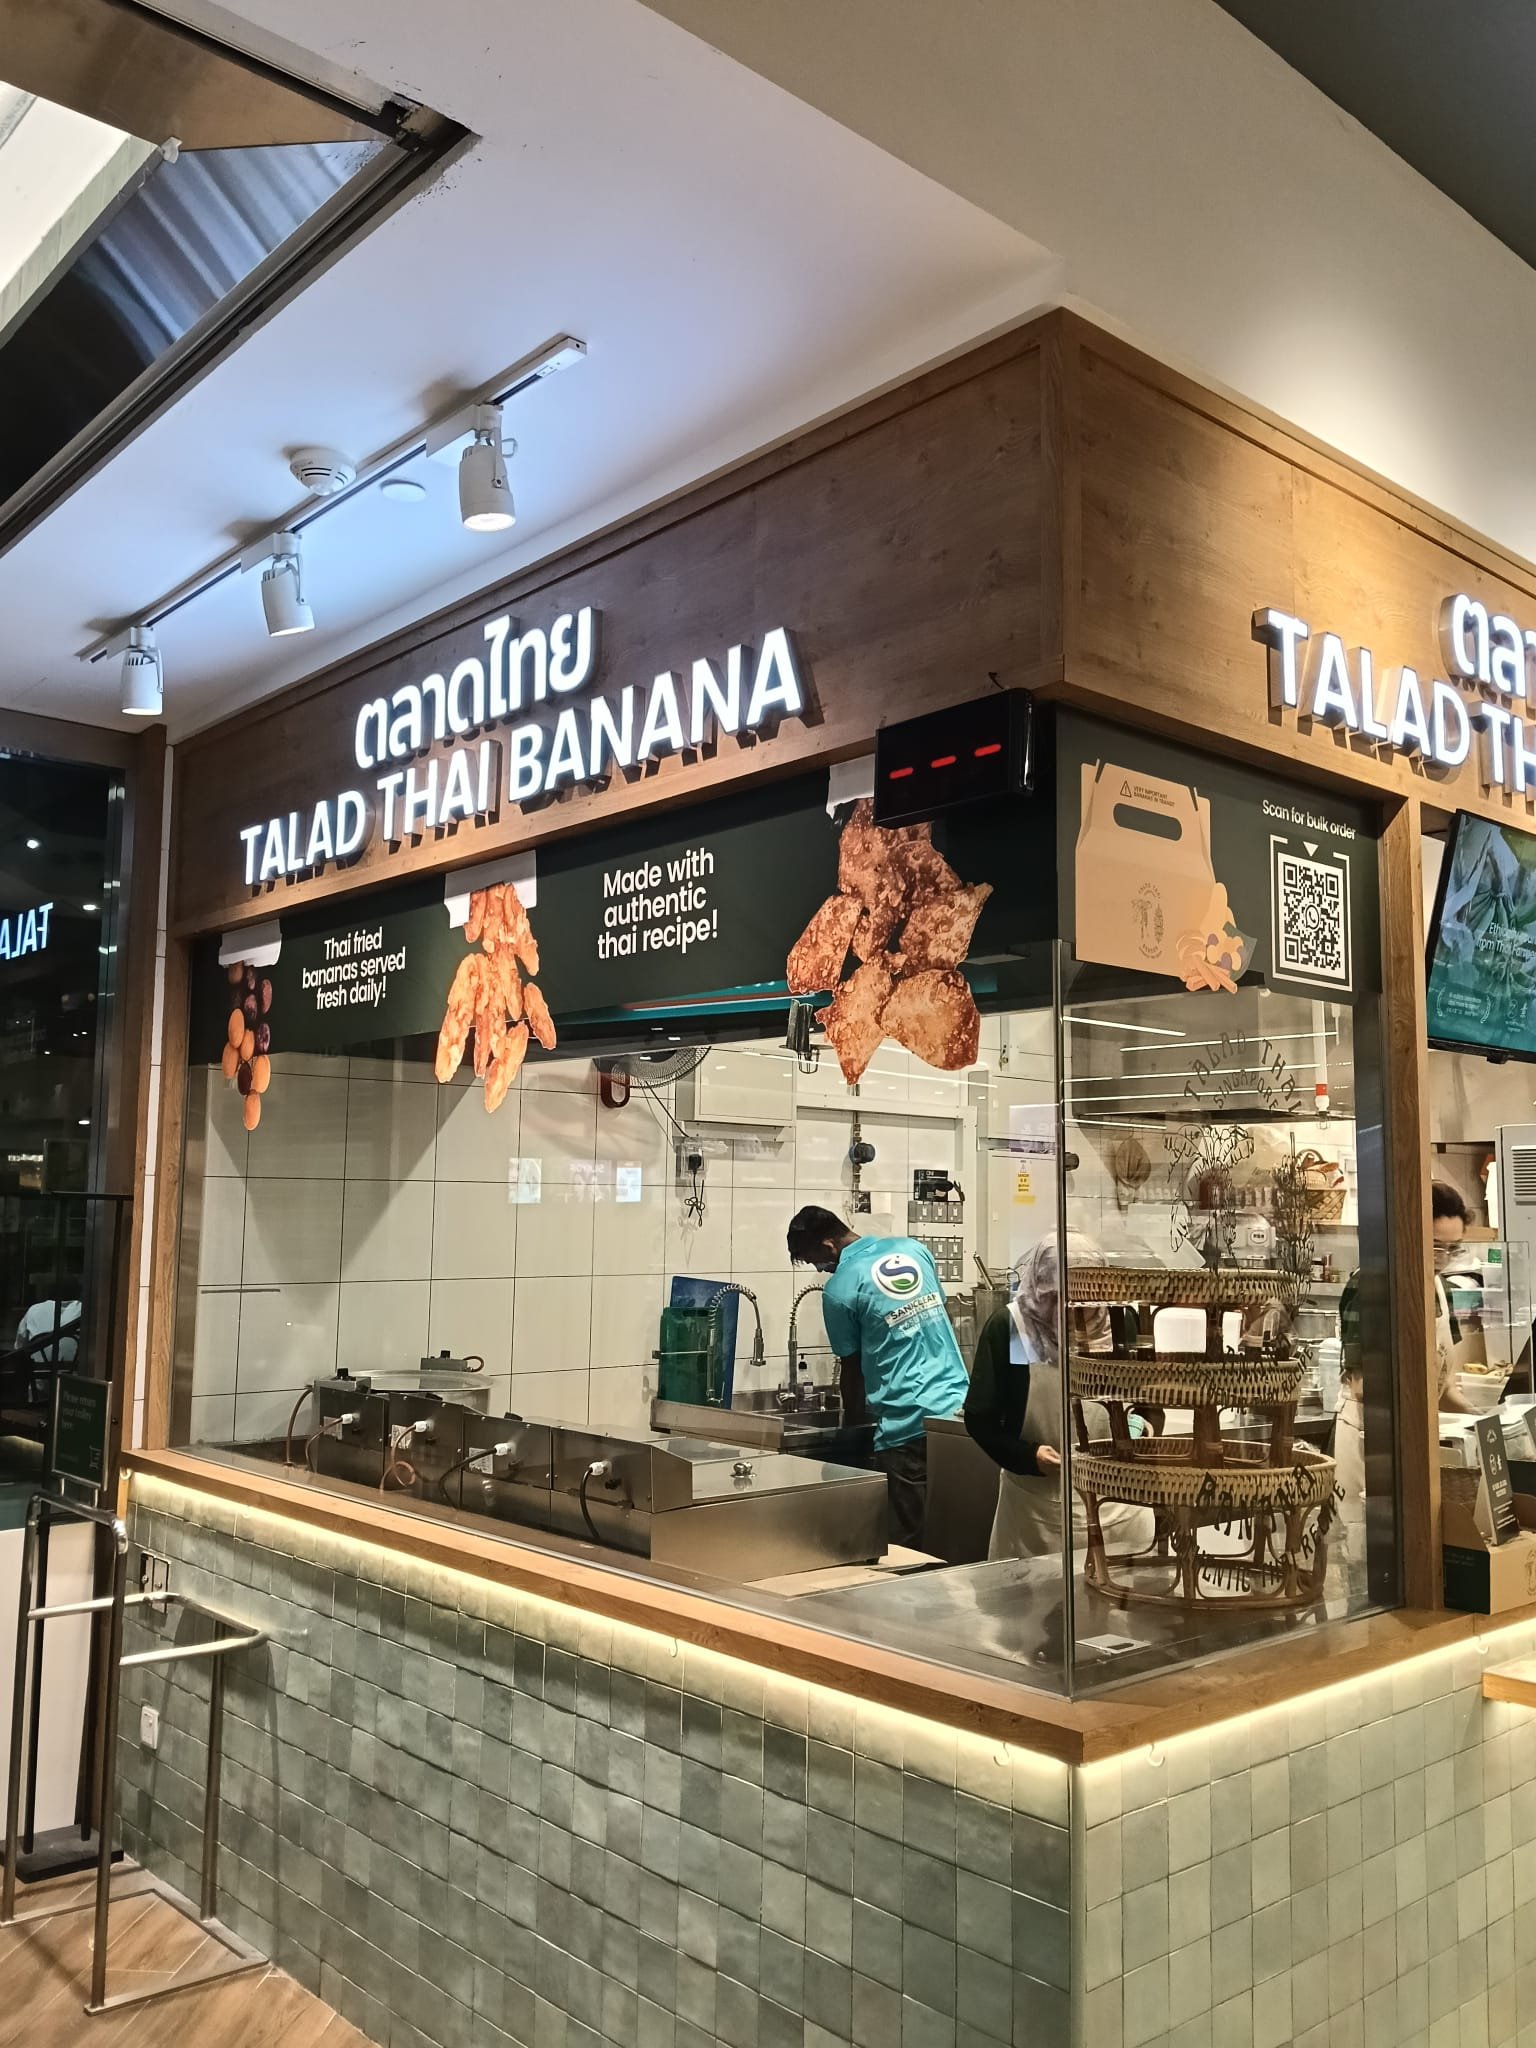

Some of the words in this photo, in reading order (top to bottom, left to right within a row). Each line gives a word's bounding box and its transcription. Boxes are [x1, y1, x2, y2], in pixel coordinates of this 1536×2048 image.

[355, 606, 594, 769] ตลาดไทย
[1267, 607, 1471, 766] TALAD
[240, 790, 367, 885] TALAD
[376, 740, 489, 842] THAI
[508, 626, 803, 803] BANANA
[1262, 799, 1290, 821] Scan
[1291, 807, 1305, 825] for
[1307, 811, 1329, 833] bulk
[1330, 822, 1357, 841] order
[603, 861, 662, 898] Made
[666, 847, 714, 883] with
[604, 881, 707, 928] authentic
[324, 931, 351, 960] Thai
[353, 926, 383, 954] fried
[598, 925, 637, 959] thai
[642, 908, 718, 954] recipe!
[302, 962, 358, 989] bananas
[360, 945, 406, 977] served
[316, 983, 347, 1010] fresh
[349, 975, 387, 1008] daily!
[1183, 1030, 1247, 1101] TALAD
[1261, 1038, 1302, 1113] THAI
[1213, 1069, 1279, 1111] SINGAPORE
